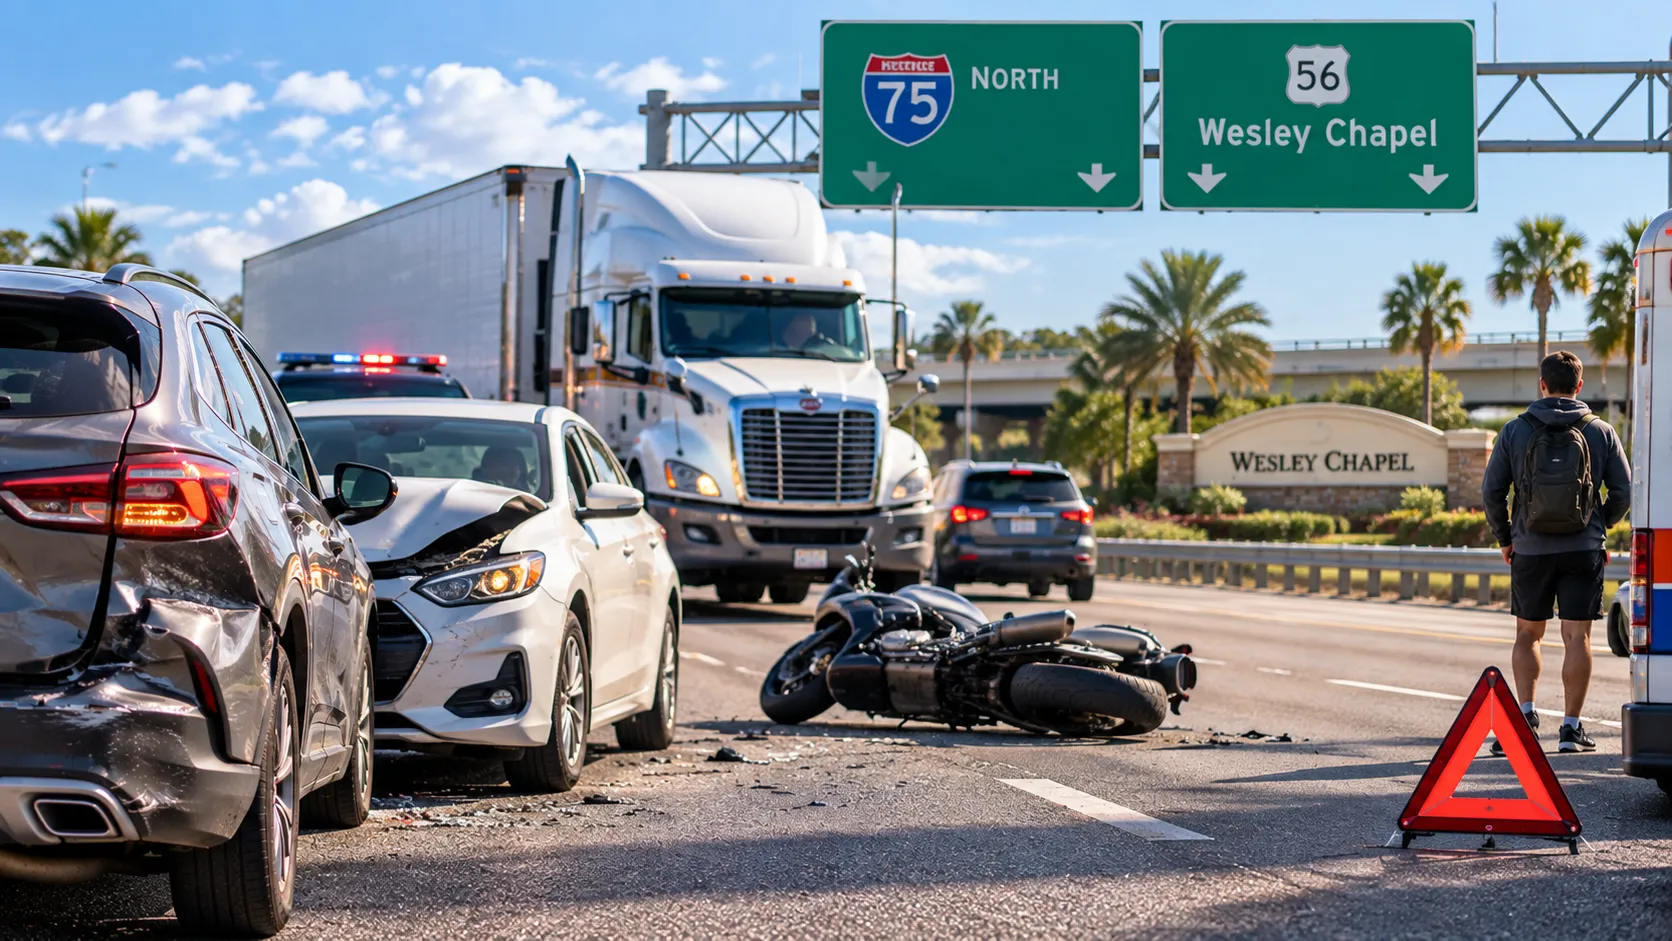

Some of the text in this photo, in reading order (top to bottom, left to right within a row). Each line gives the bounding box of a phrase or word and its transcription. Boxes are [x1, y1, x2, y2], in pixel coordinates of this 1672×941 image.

[971, 66, 1059, 90] NORTH
[1296, 60, 1341, 91] 56
[877, 81, 938, 125] 75
[1198, 117, 1437, 154] Wesley Chapel
[1230, 450, 1415, 472] WESLEY CHAPEL
